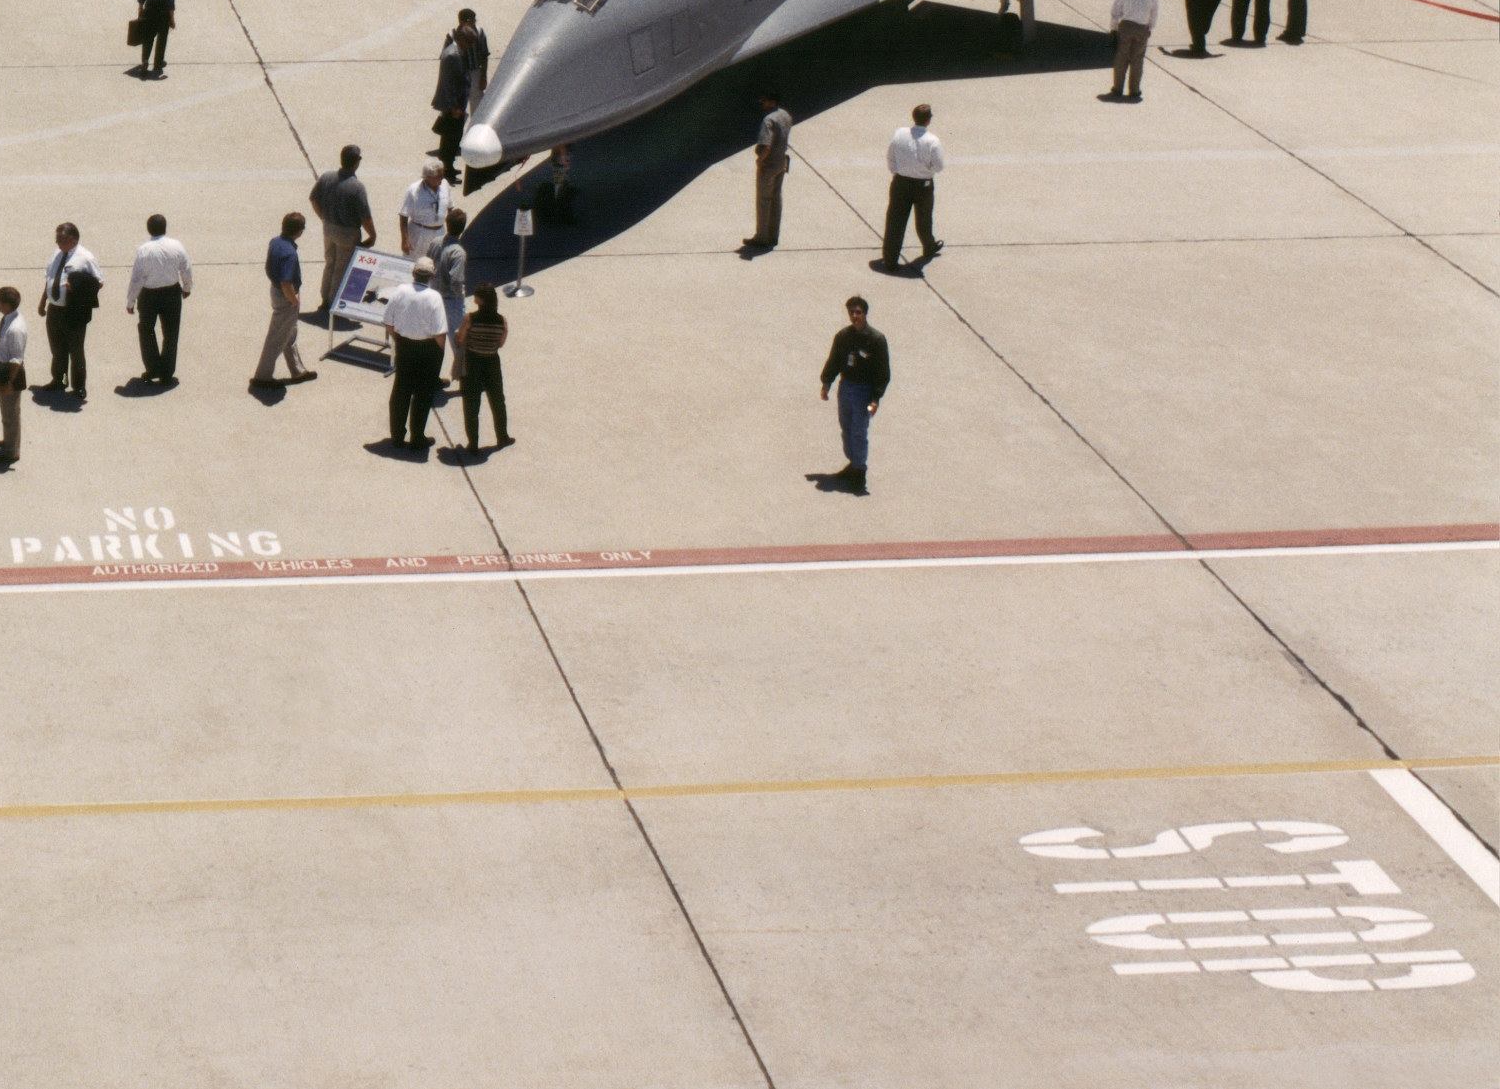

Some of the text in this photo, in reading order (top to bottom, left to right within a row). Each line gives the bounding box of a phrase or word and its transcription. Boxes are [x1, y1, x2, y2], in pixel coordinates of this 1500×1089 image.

[357, 254, 377, 266] X-34
[103, 506, 176, 532] NO
[10, 530, 282, 564] PARKING
[91, 549, 653, 576] AUTHORIZED VEHICLES AND PERSONNEL ONLY
[1017, 820, 1477, 993] STOP
